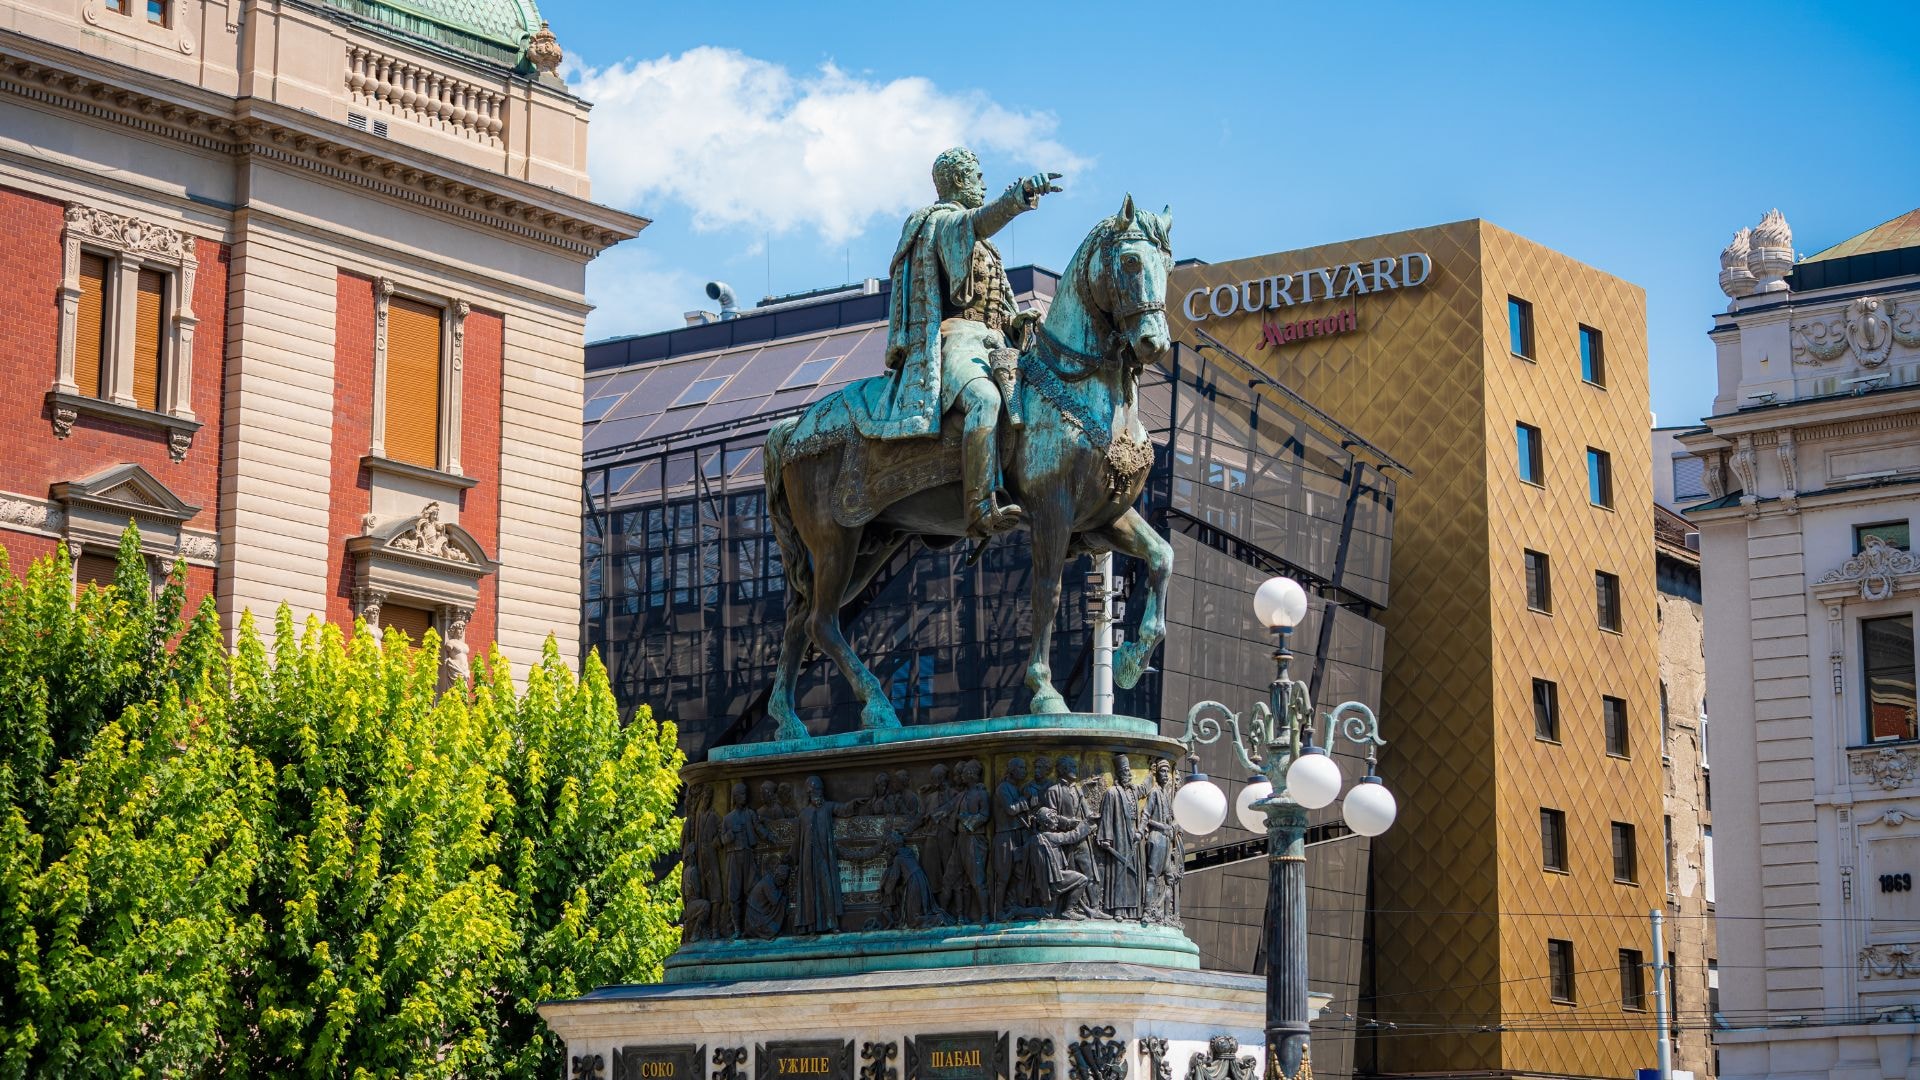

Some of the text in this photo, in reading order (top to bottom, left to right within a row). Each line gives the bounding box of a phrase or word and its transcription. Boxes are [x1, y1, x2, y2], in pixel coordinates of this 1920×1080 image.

[1183, 252, 1432, 322] COURTYARD
[1256, 309, 1356, 350] Marriott
[1879, 873, 1912, 894] 1869
[778, 1057, 829, 1074] УЖИЦЕ
[931, 1050, 982, 1069] ШАБАЦ
[641, 1062, 675, 1078] СОКО
